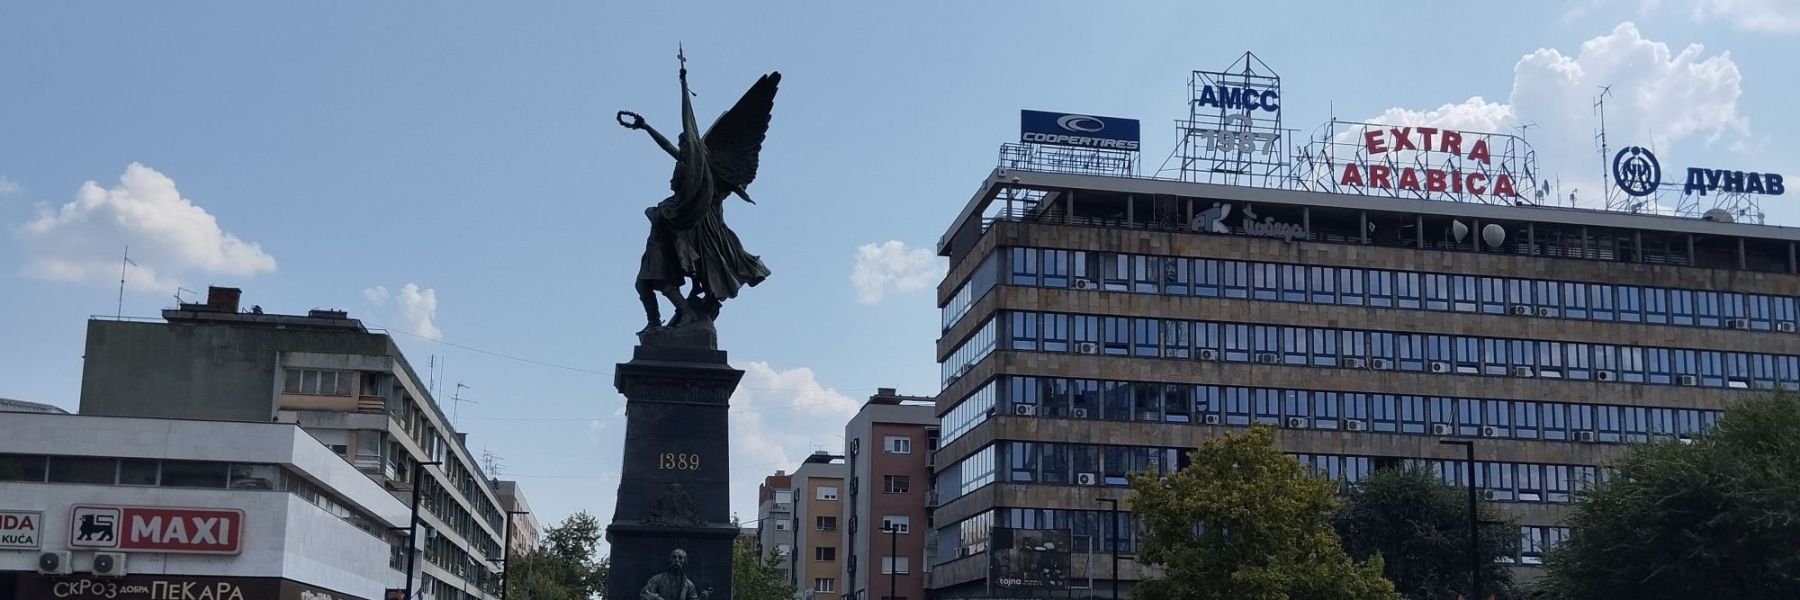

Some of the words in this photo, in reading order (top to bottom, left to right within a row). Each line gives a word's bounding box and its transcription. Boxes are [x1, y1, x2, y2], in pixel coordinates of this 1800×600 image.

[1200, 129, 1276, 156] 1987
[1364, 126, 1492, 165] EXTRA
[1340, 162, 1517, 198] ARABICA
[1685, 167, 1785, 196] ДУНАВ
[2, 533, 33, 544] KUĆA
[130, 515, 229, 545] MAXI
[53, 579, 117, 599] СКРОЗ
[119, 585, 149, 594] ДОБРА
